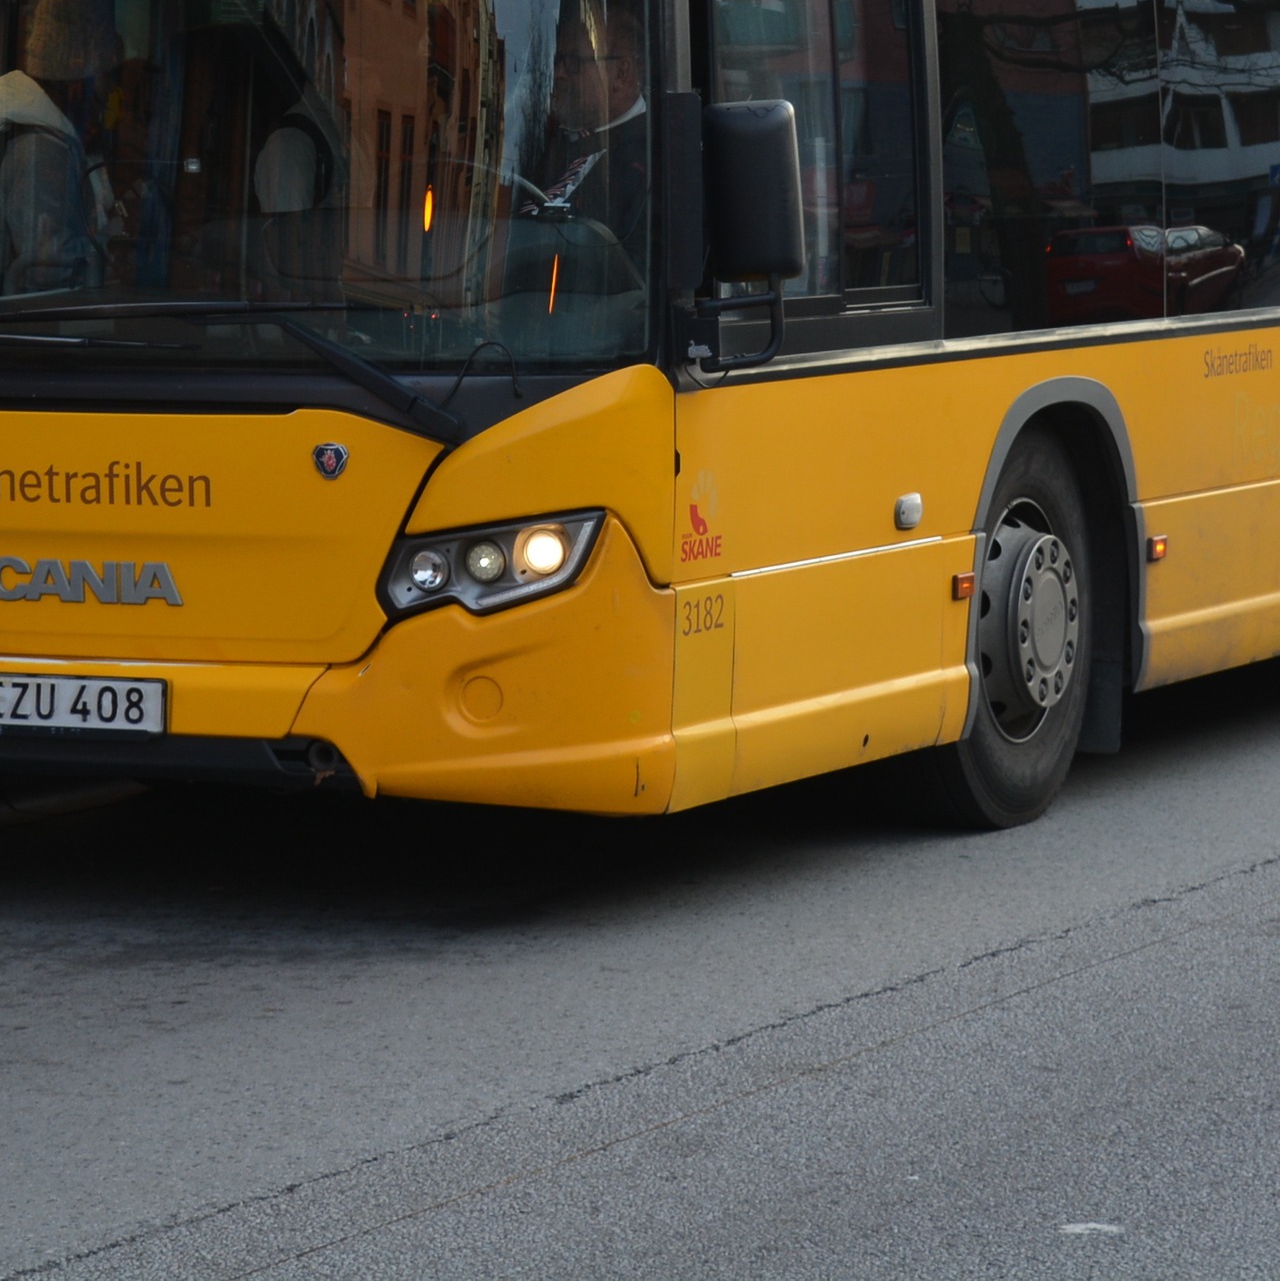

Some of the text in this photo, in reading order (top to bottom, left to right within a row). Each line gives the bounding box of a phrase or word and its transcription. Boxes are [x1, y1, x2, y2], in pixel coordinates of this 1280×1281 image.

[1203, 343, 1273, 378] Skånetrafiken
[682, 594, 724, 636] 3182
[70, 685, 145, 724] 408
